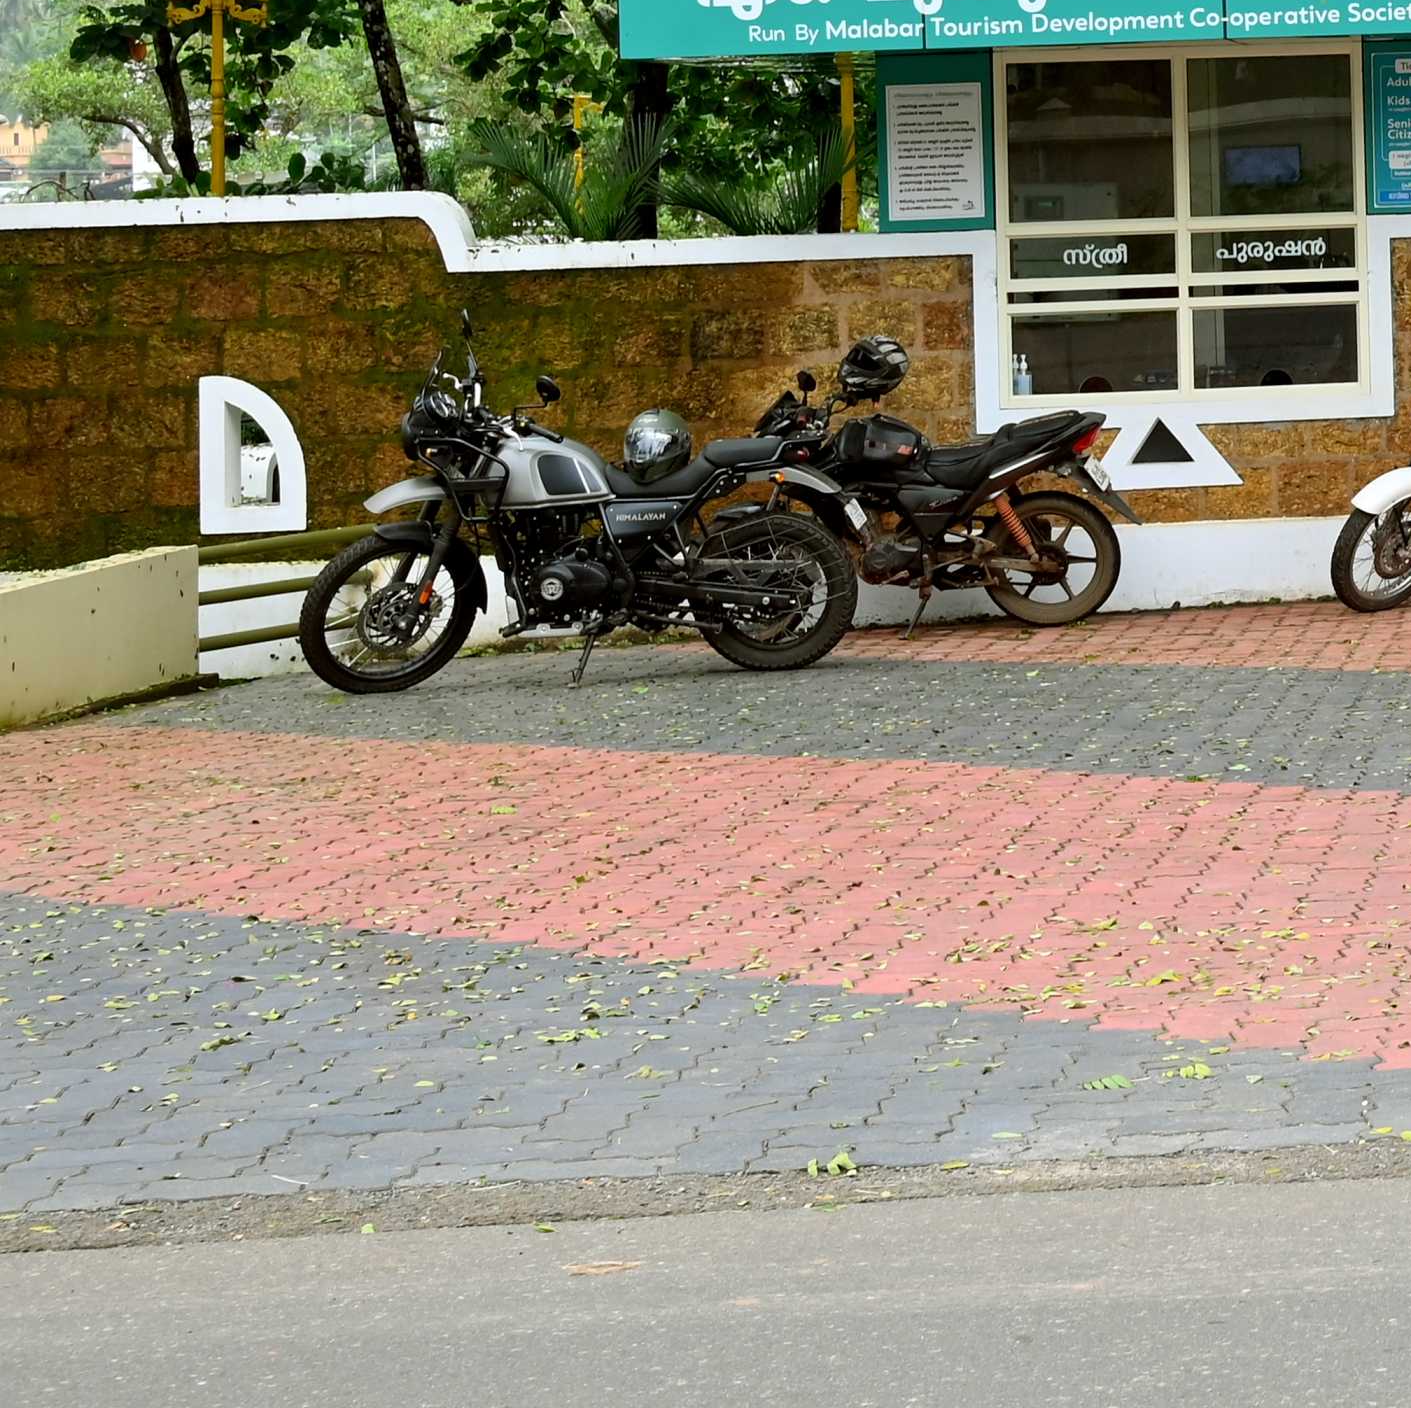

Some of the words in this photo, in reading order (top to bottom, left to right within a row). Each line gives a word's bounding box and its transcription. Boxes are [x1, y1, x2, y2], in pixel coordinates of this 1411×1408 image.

[748, 25, 786, 43] Run
[795, 24, 820, 45] By
[826, 18, 925, 41] Malabar
[931, 16, 1024, 37] Tourism
[1032, 12, 1185, 38] Development
[1190, 5, 1341, 31] Co-operative
[1387, 95, 1411, 106] Kids
[1062, 243, 1129, 269] സ്ത്രീ
[1215, 237, 1327, 264] പുരുഷൻ
[616, 512, 666, 521] HIMALAYAN
